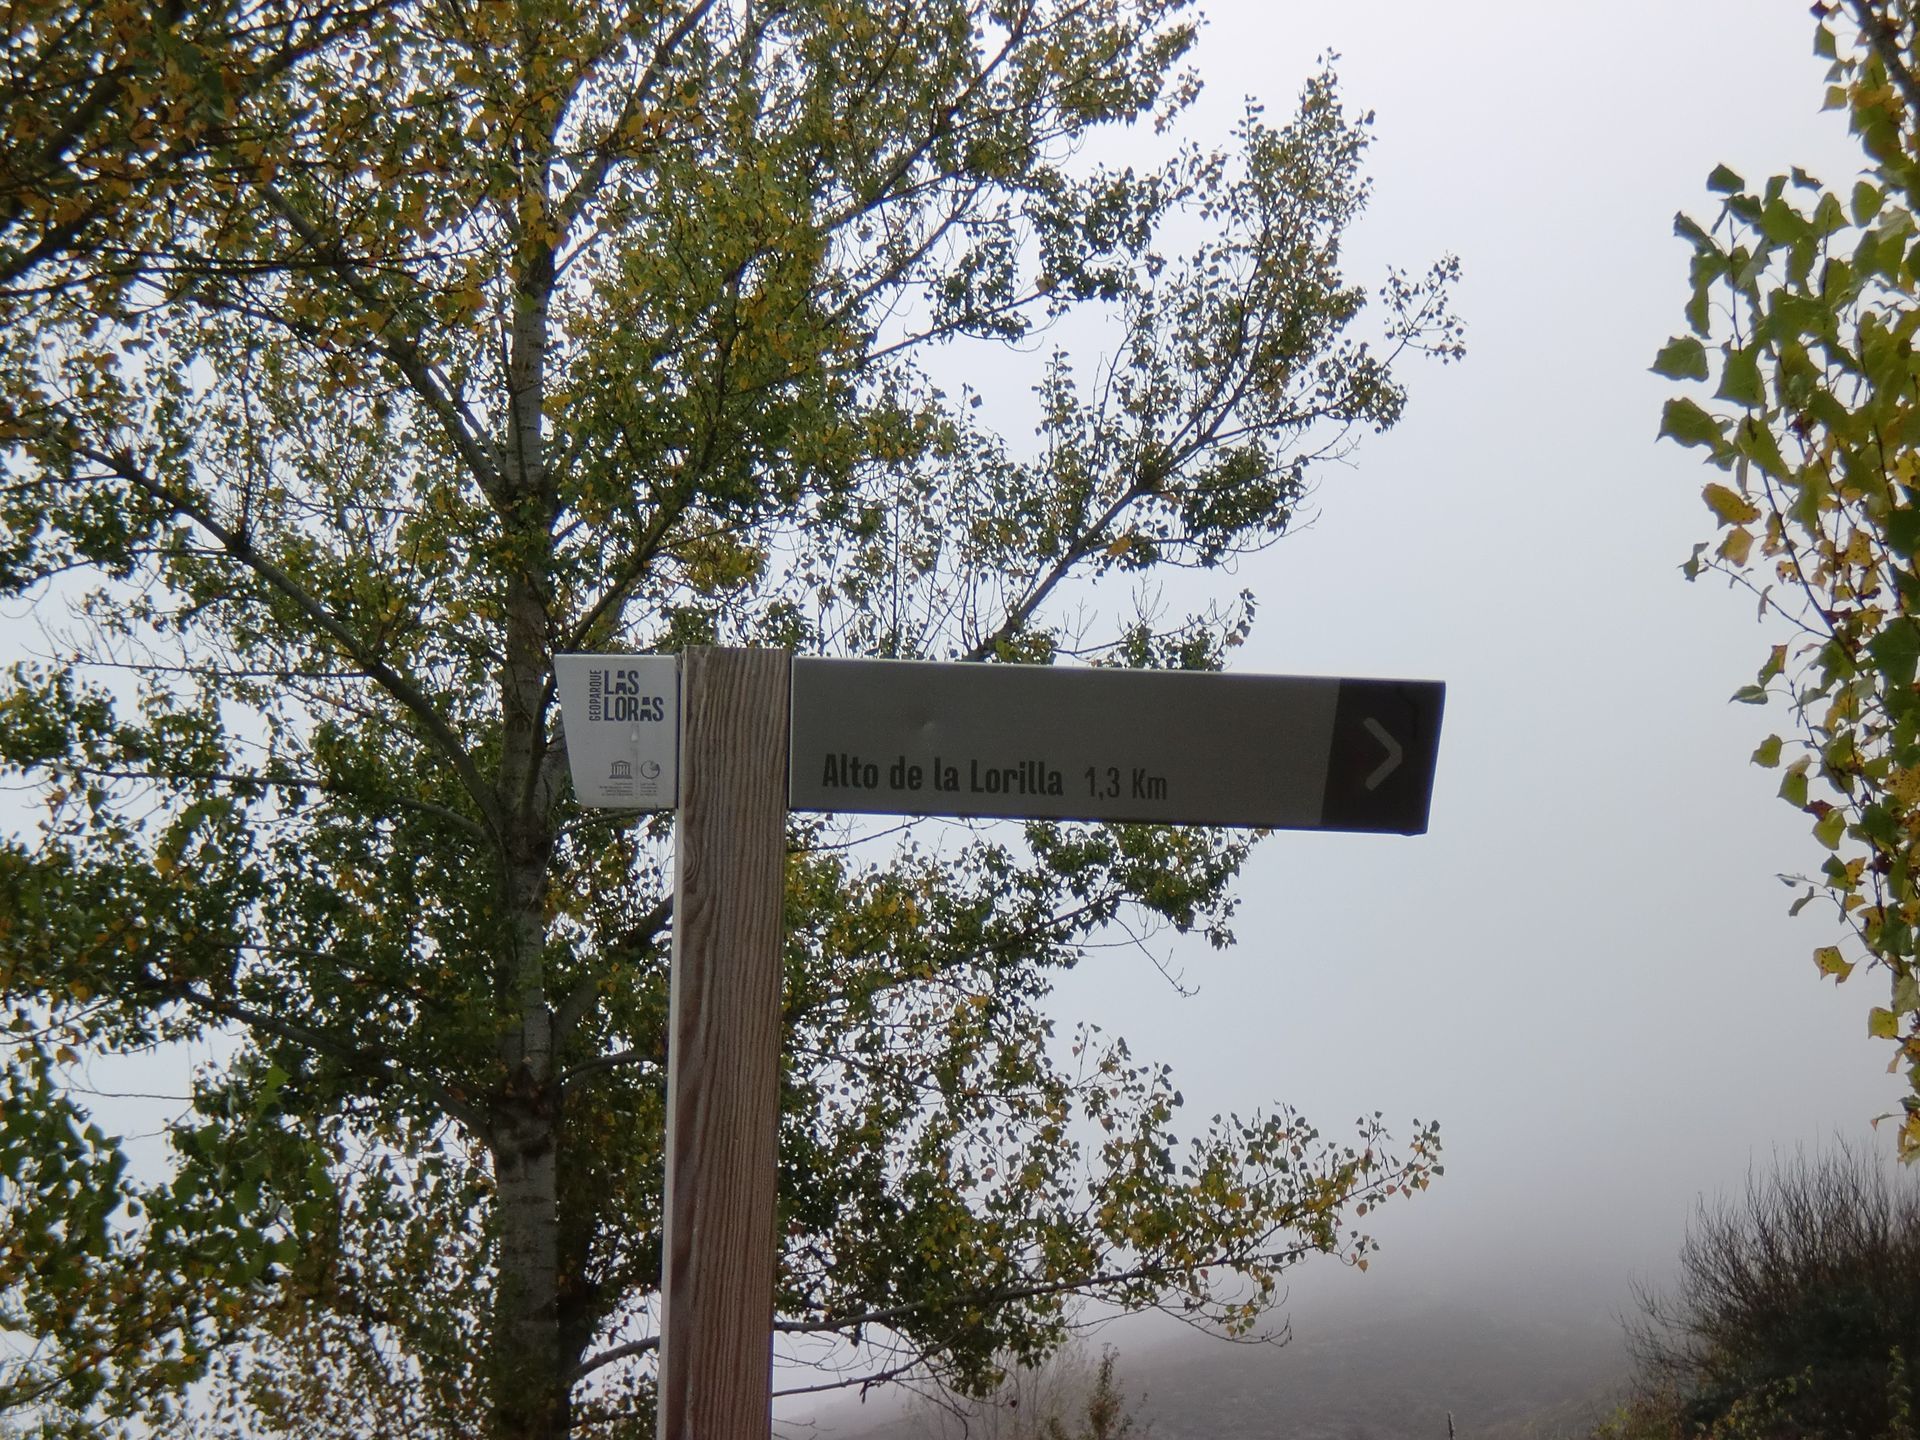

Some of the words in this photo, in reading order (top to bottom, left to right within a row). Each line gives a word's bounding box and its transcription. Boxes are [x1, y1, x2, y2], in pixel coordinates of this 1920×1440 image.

[589, 669, 602, 721] GEOPARQUE
[604, 670, 640, 695] LAS
[603, 696, 664, 722] LORAS
[822, 753, 879, 790] Alto
[889, 755, 923, 791] de
[934, 756, 960, 792] la
[970, 759, 1064, 796] Lorilla
[1084, 766, 1120, 801] 1,3
[1132, 767, 1167, 800] Km
